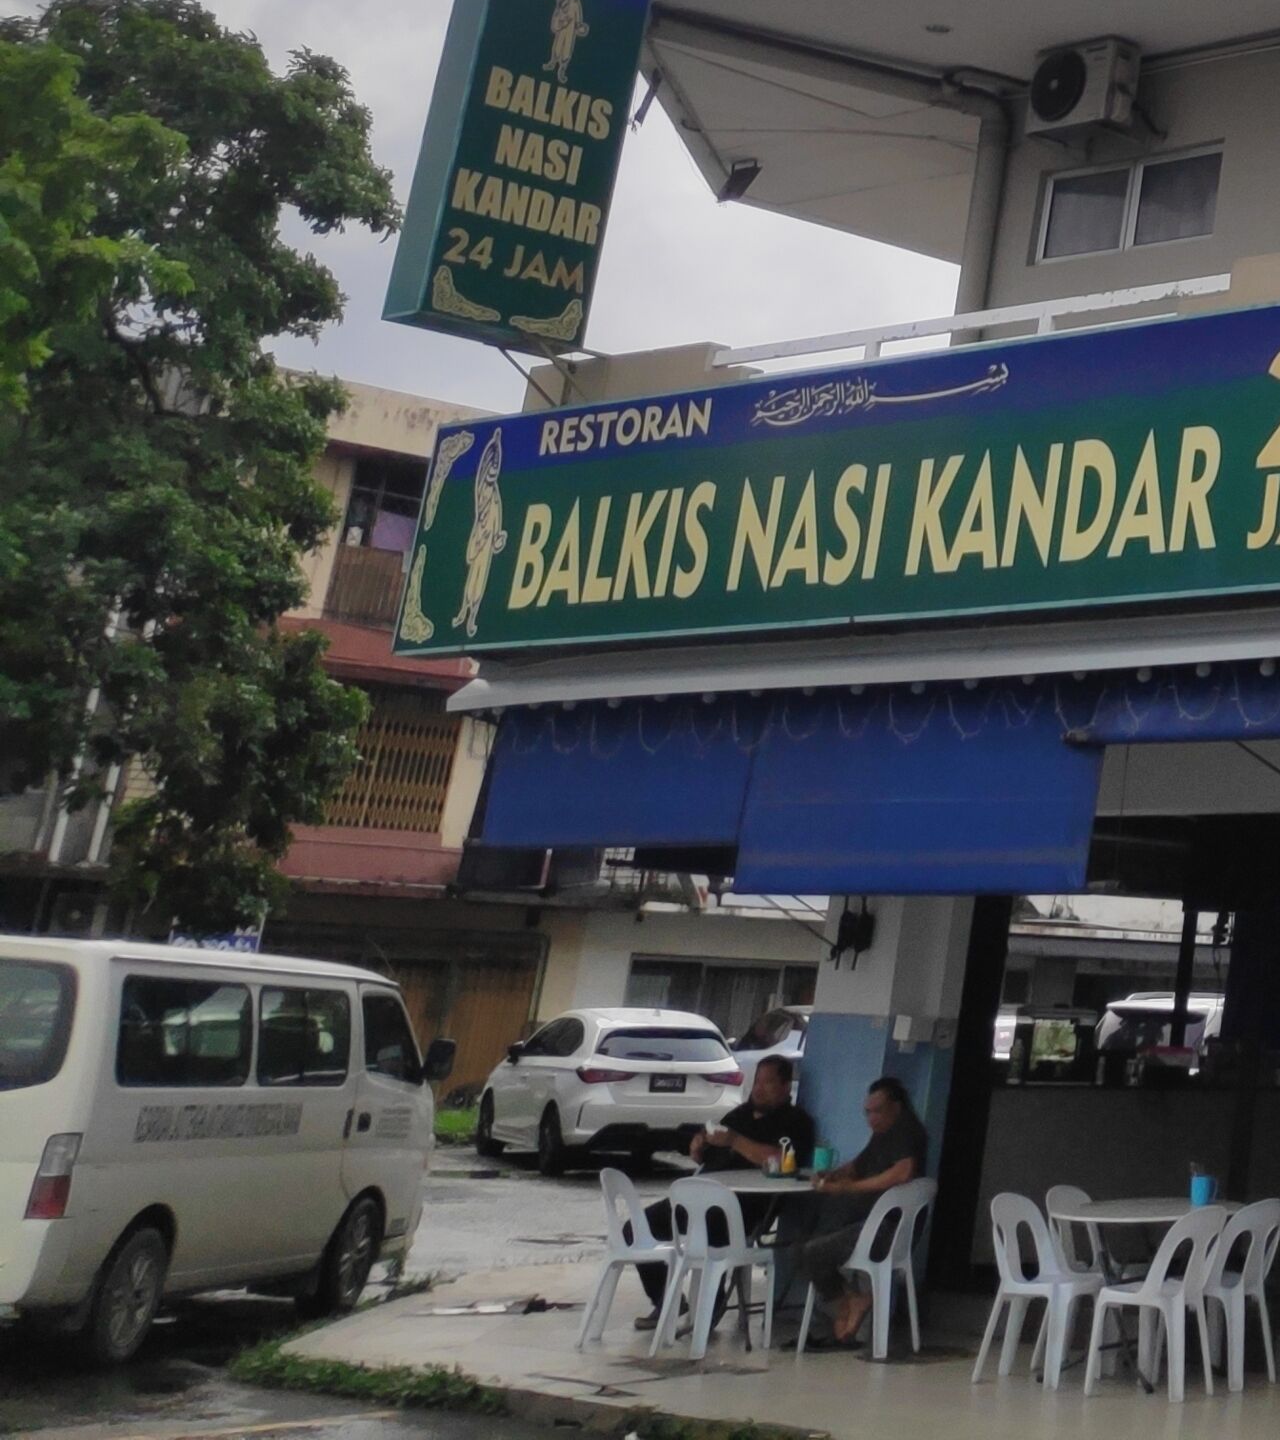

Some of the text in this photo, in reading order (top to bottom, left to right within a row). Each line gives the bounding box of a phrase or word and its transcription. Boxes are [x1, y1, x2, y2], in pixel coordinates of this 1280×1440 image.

[485, 65, 613, 141] BALKIS
[494, 123, 584, 186] NASI
[452, 167, 601, 246] KANDAR
[443, 227, 584, 295] 24 JAM
[539, 397, 713, 456] RESTORAN
[507, 424, 1222, 610] BALKIS NASI KANDAR
